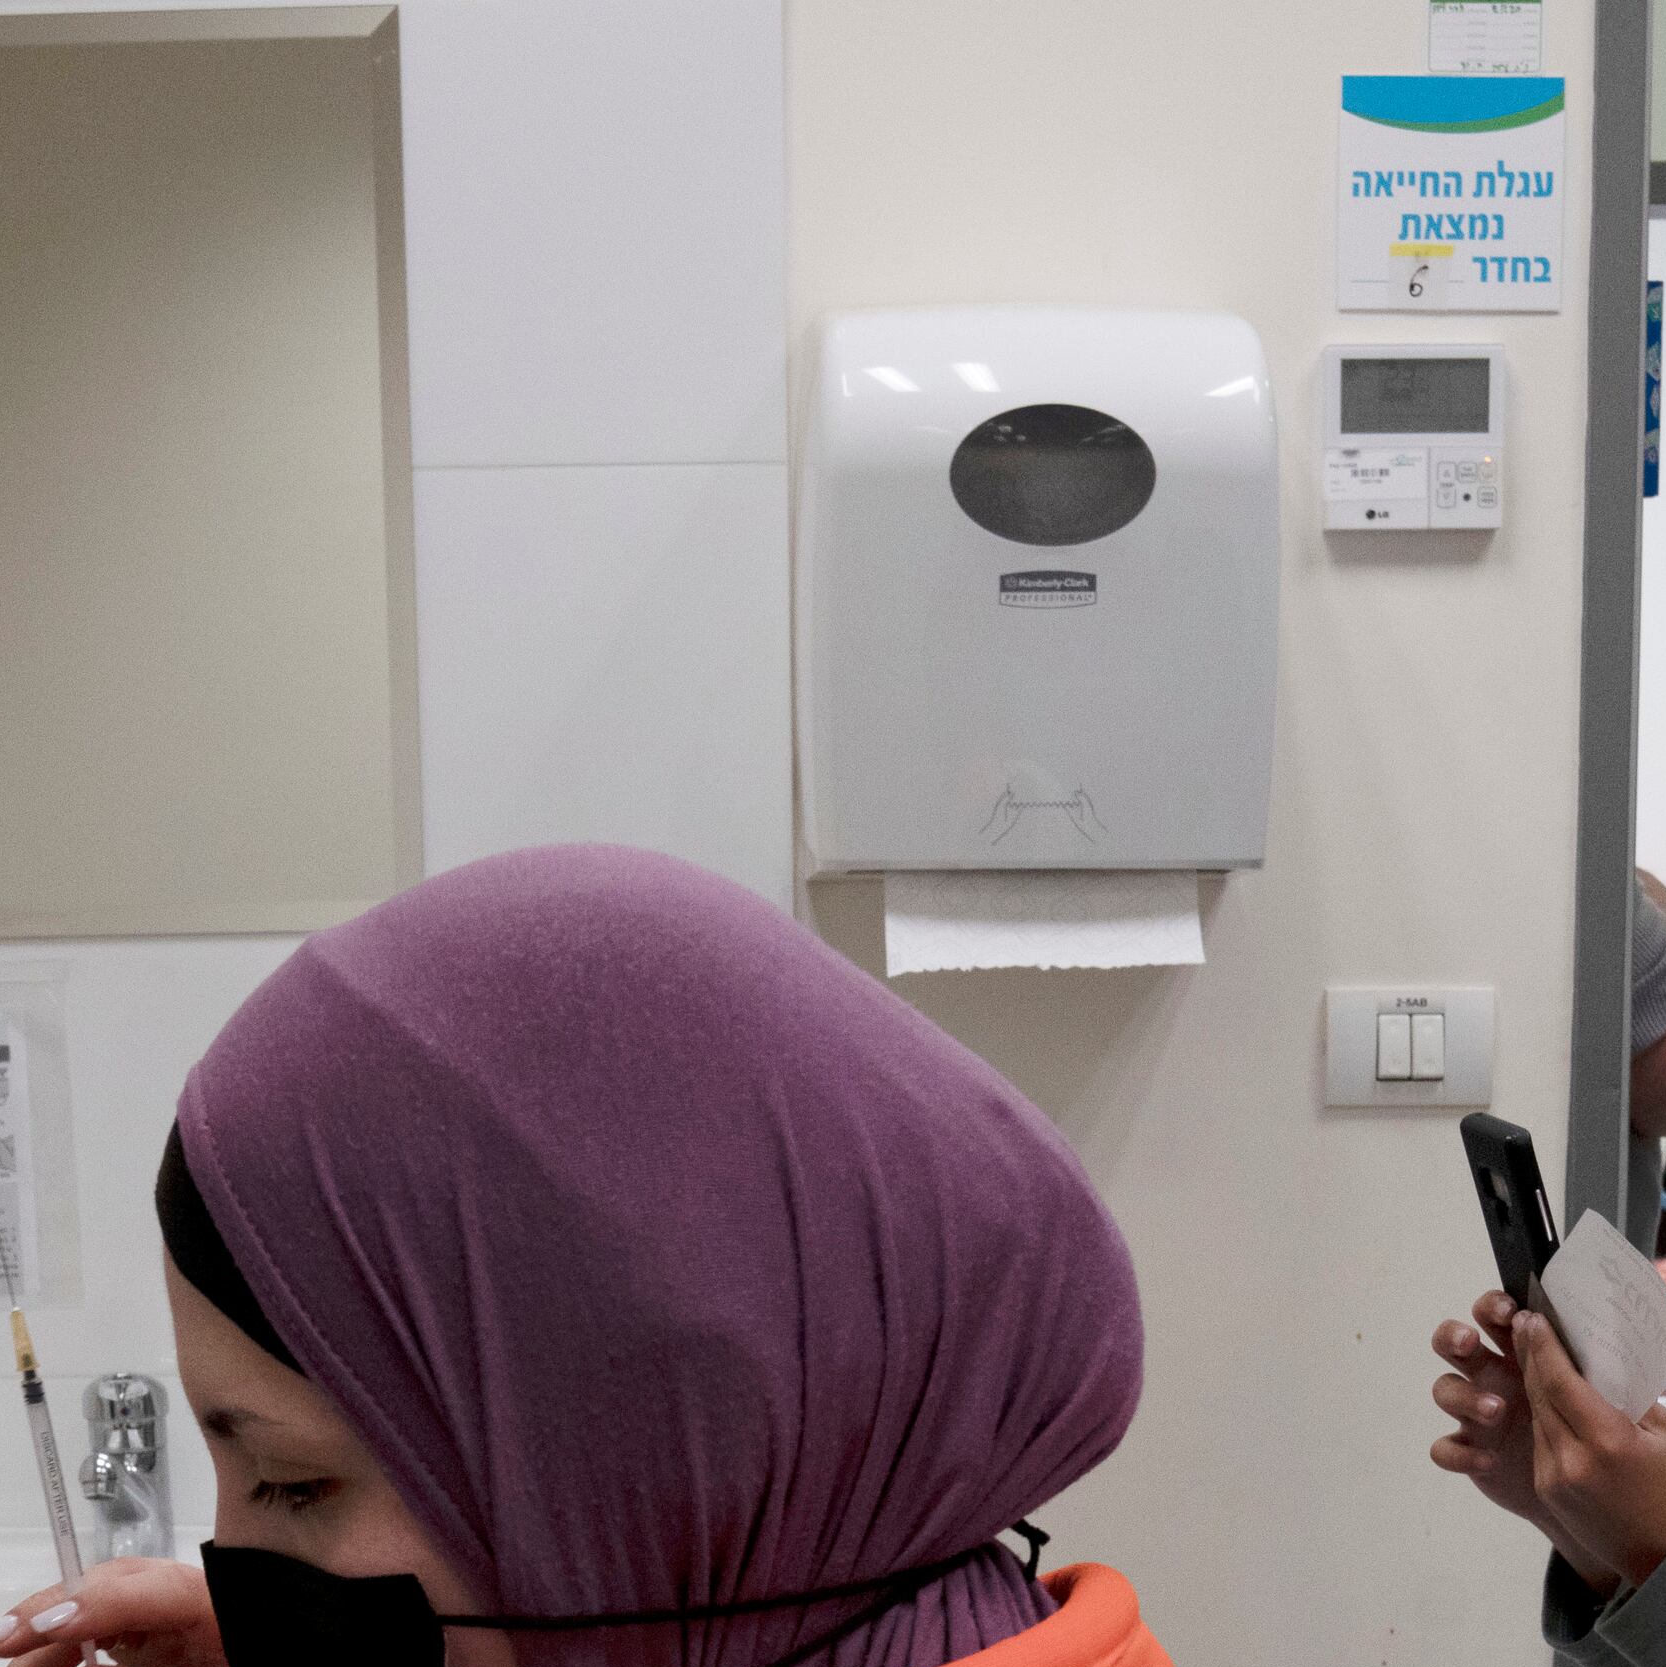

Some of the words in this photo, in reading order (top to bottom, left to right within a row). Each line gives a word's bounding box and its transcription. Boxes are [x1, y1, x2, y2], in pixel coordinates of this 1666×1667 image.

[1351, 170, 1463, 198] החייאה
[1473, 160, 1555, 198] עגלת
[1398, 213, 1505, 241] נמצאת
[1472, 256, 1552, 283] בחדר
